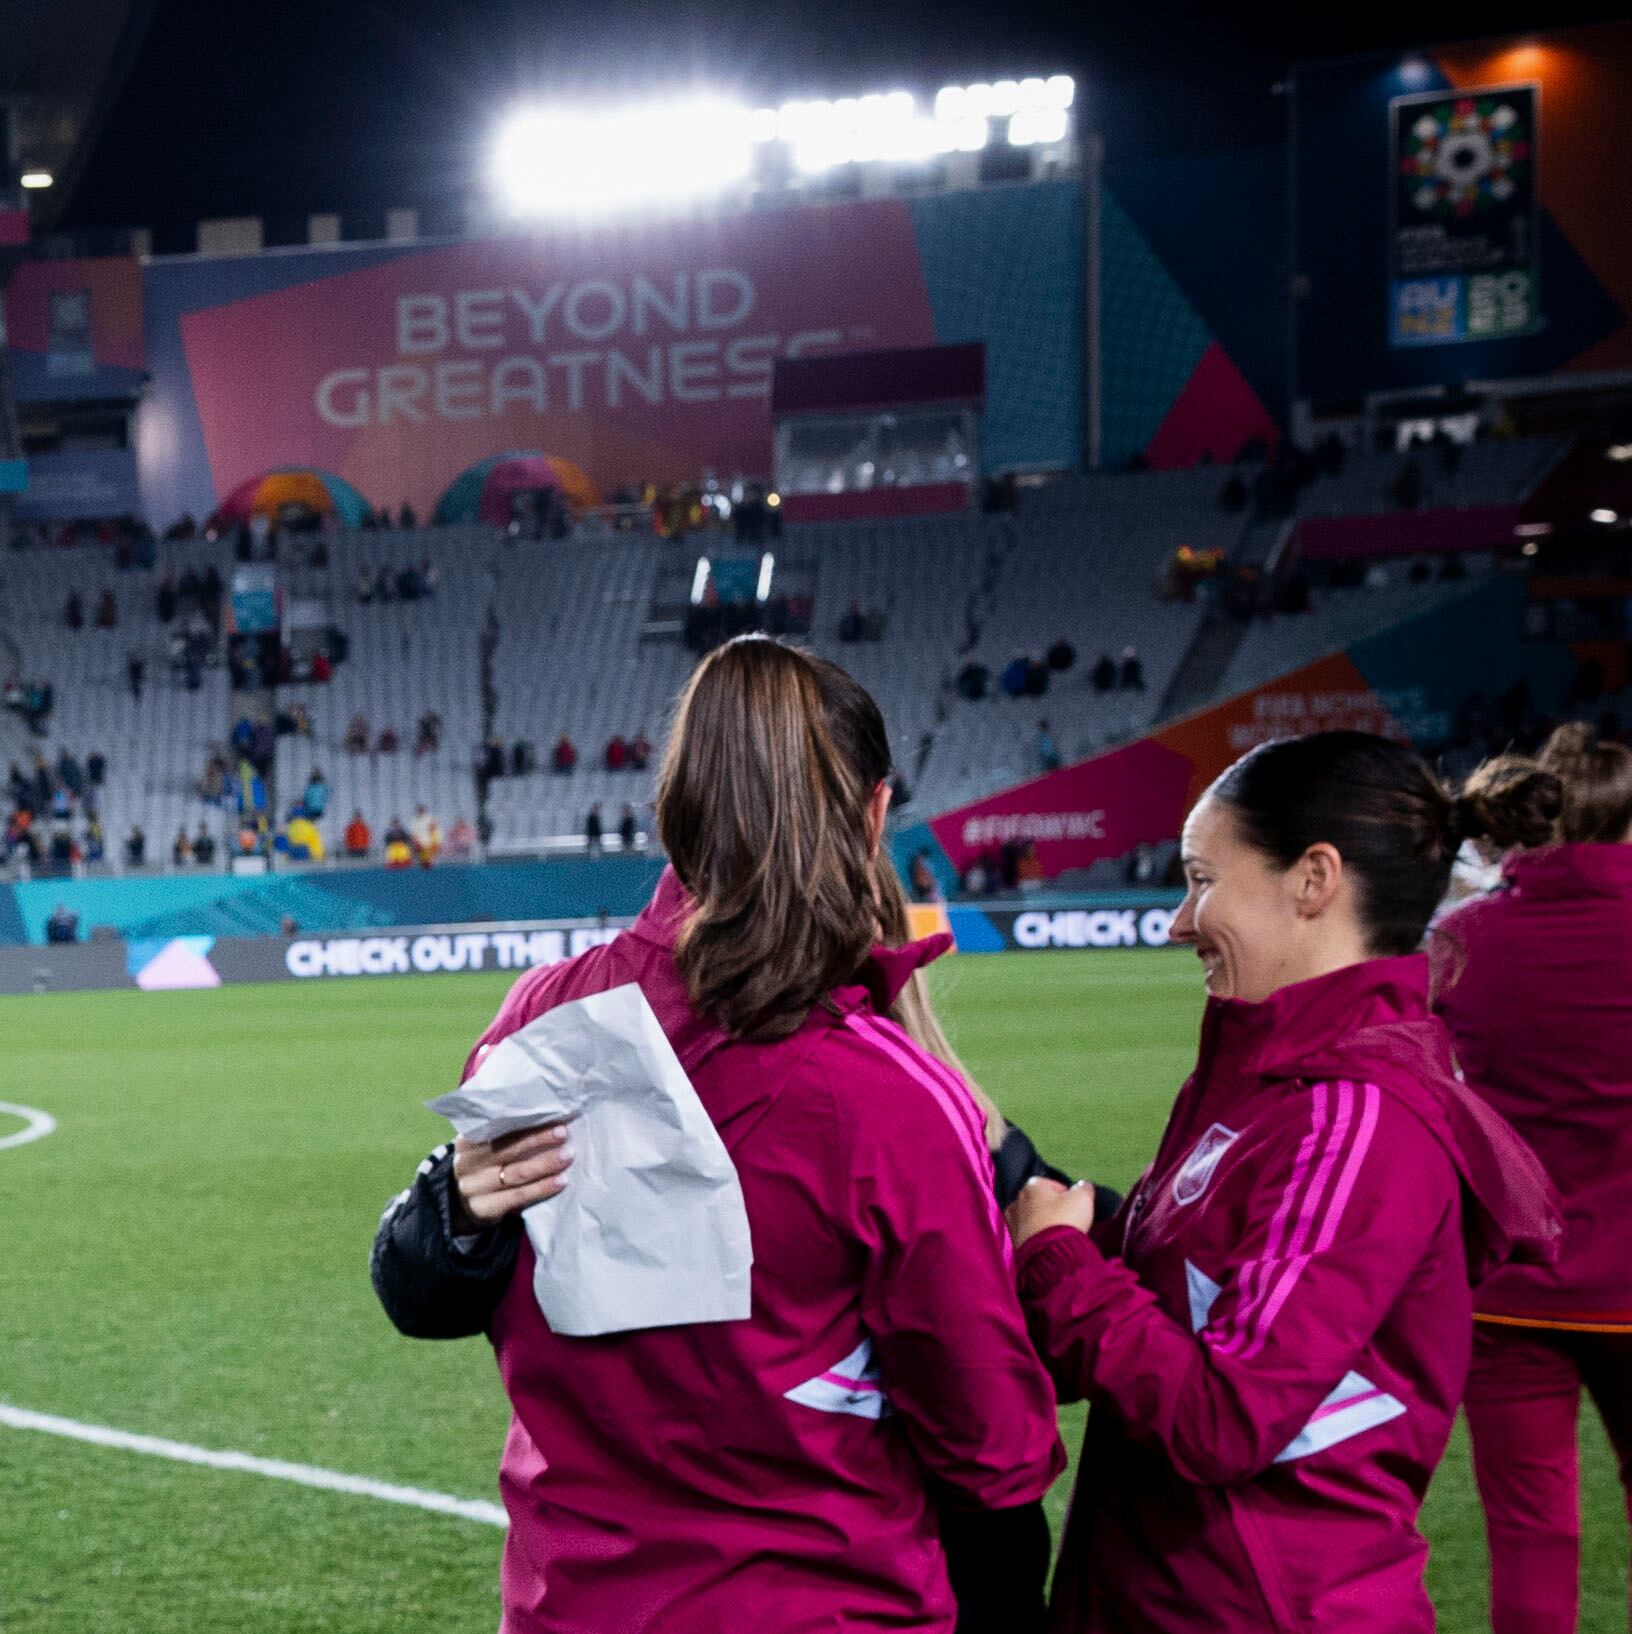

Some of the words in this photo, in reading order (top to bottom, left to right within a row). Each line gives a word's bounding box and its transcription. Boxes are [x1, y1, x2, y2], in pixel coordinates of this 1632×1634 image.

[396, 267, 758, 357] BEYOND
[286, 934, 410, 977] CHECK
[411, 930, 488, 973] OUT
[491, 927, 565, 968] THE
[1014, 910, 1137, 948] CHECK
